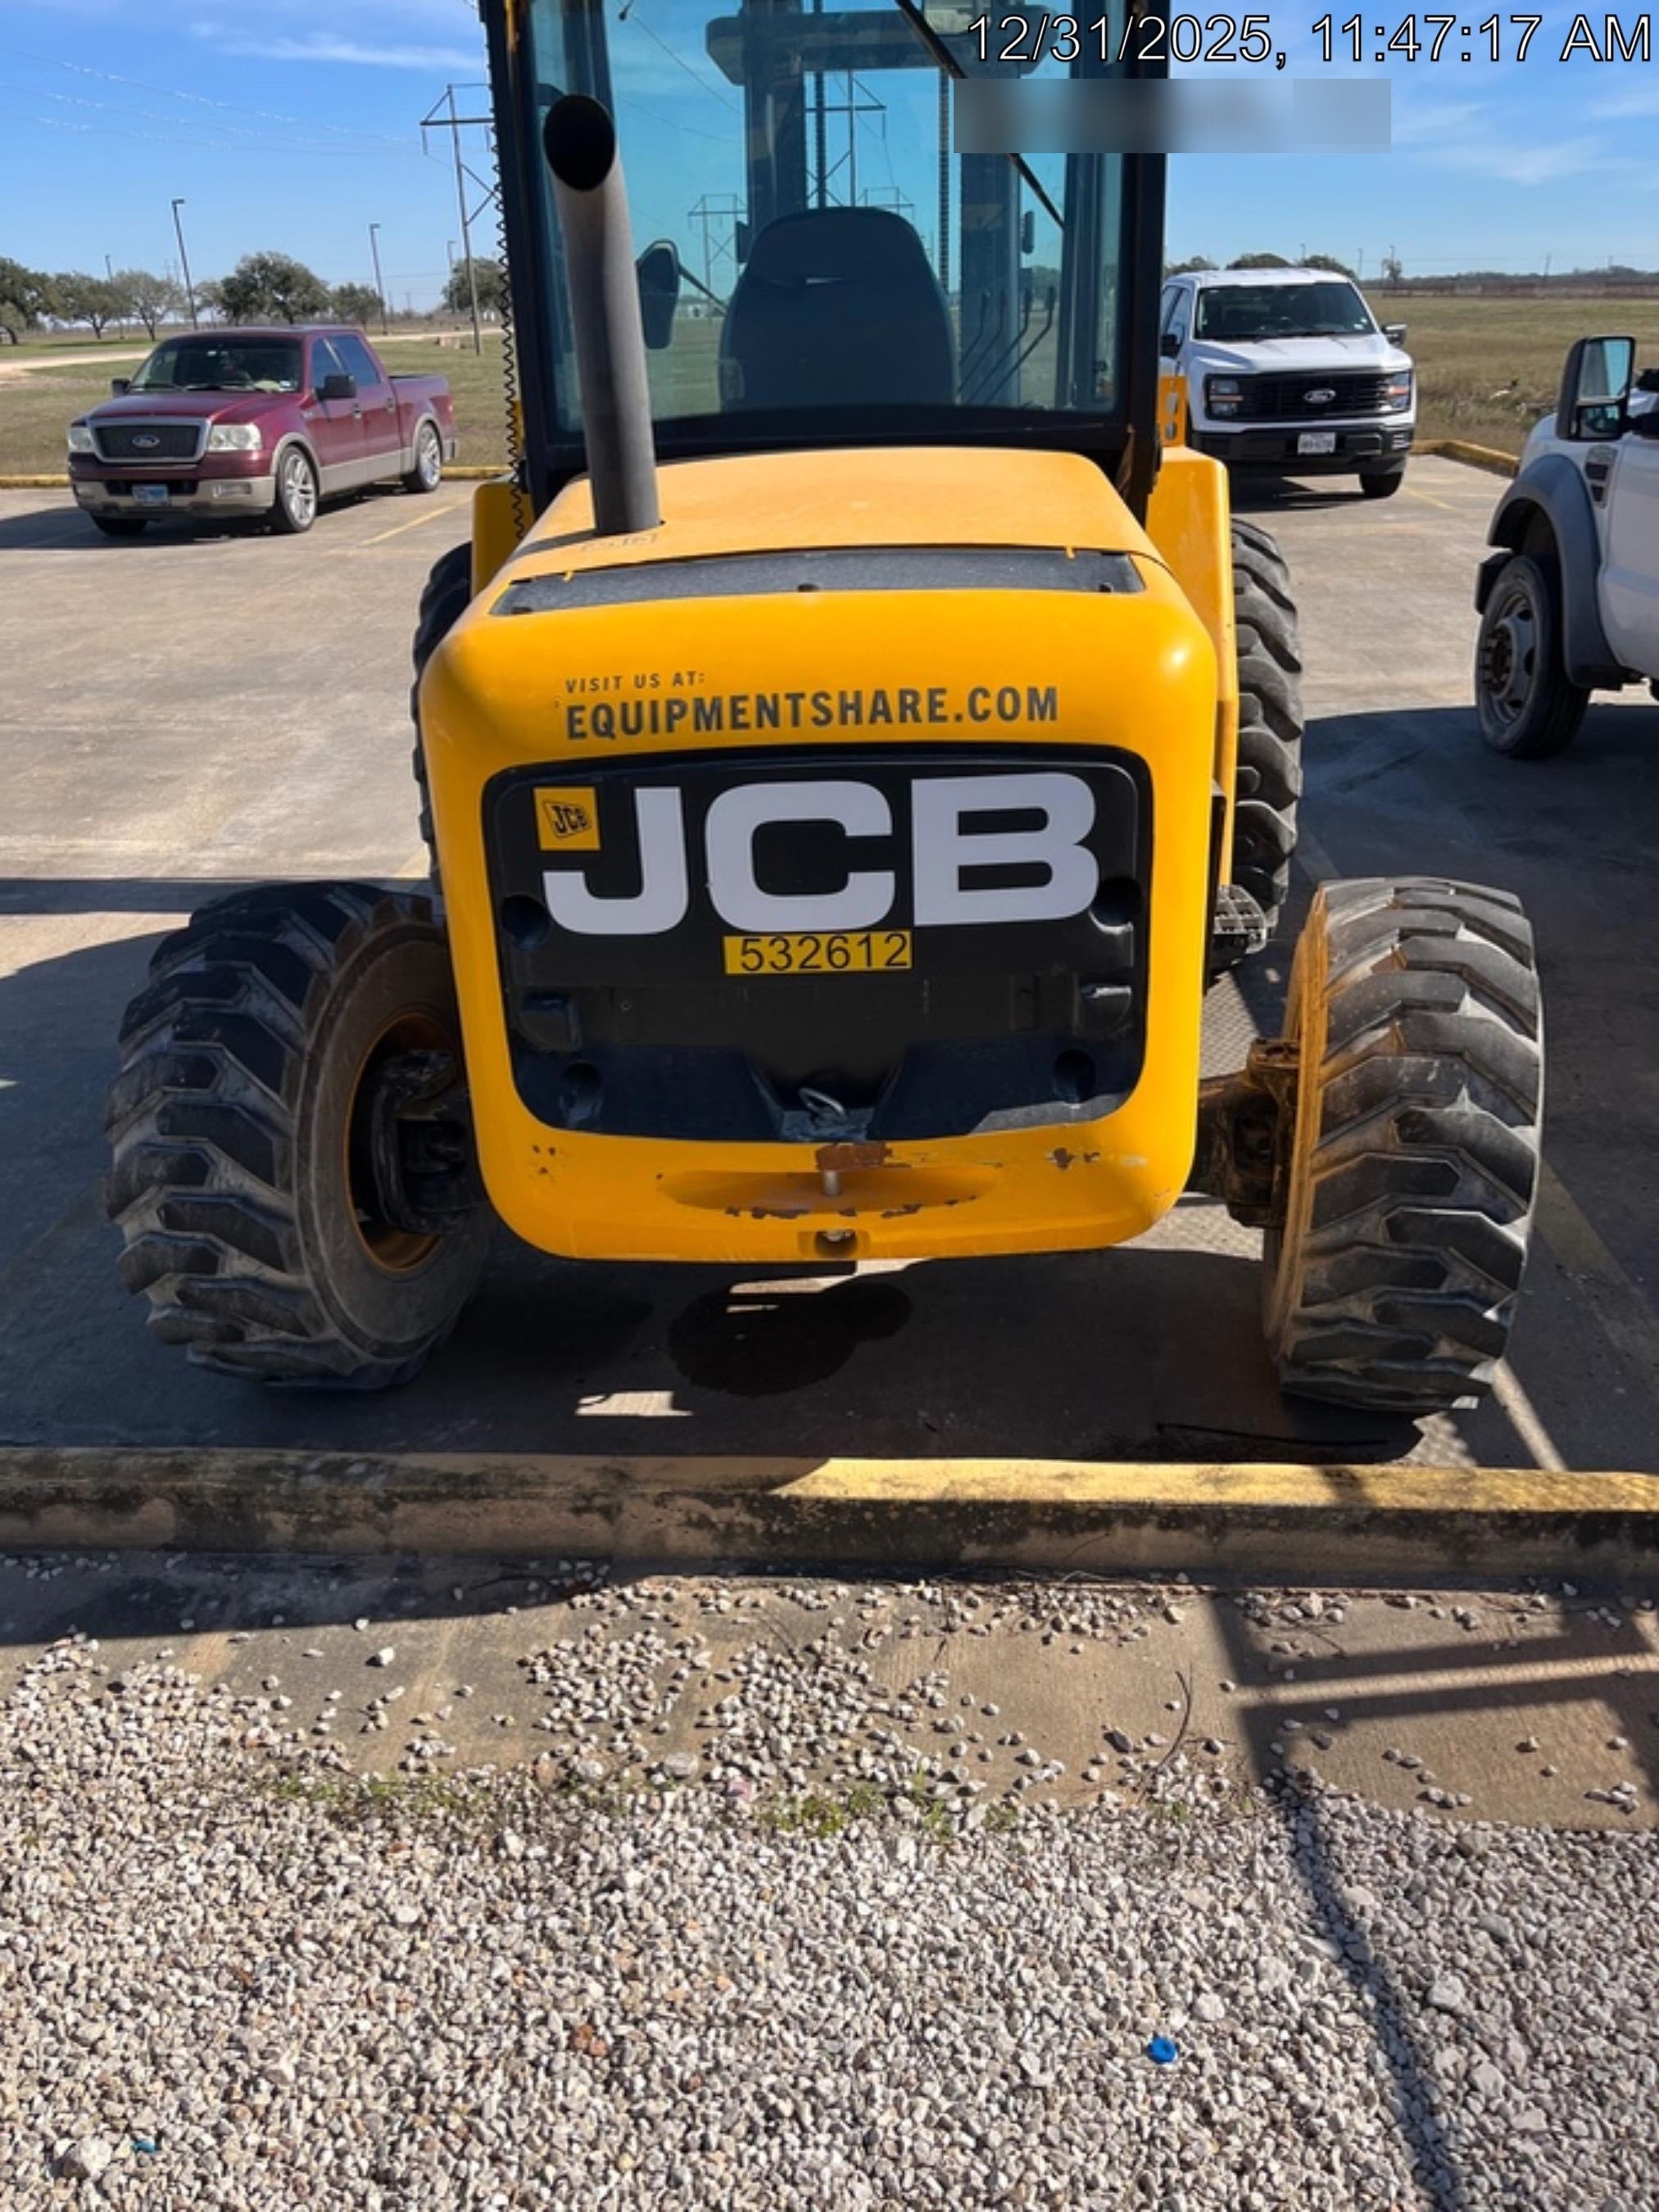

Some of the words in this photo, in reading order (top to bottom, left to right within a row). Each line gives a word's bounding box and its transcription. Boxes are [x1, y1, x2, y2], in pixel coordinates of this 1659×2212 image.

[565, 675, 623, 694] VISIT
[633, 673, 660, 689] US
[672, 669, 705, 687] AT:
[567, 686, 1058, 741] EQUIPMENTSHARE.COM
[551, 804, 589, 834] JCB
[542, 773, 1100, 935] JCB
[741, 932, 909, 972] 532612
